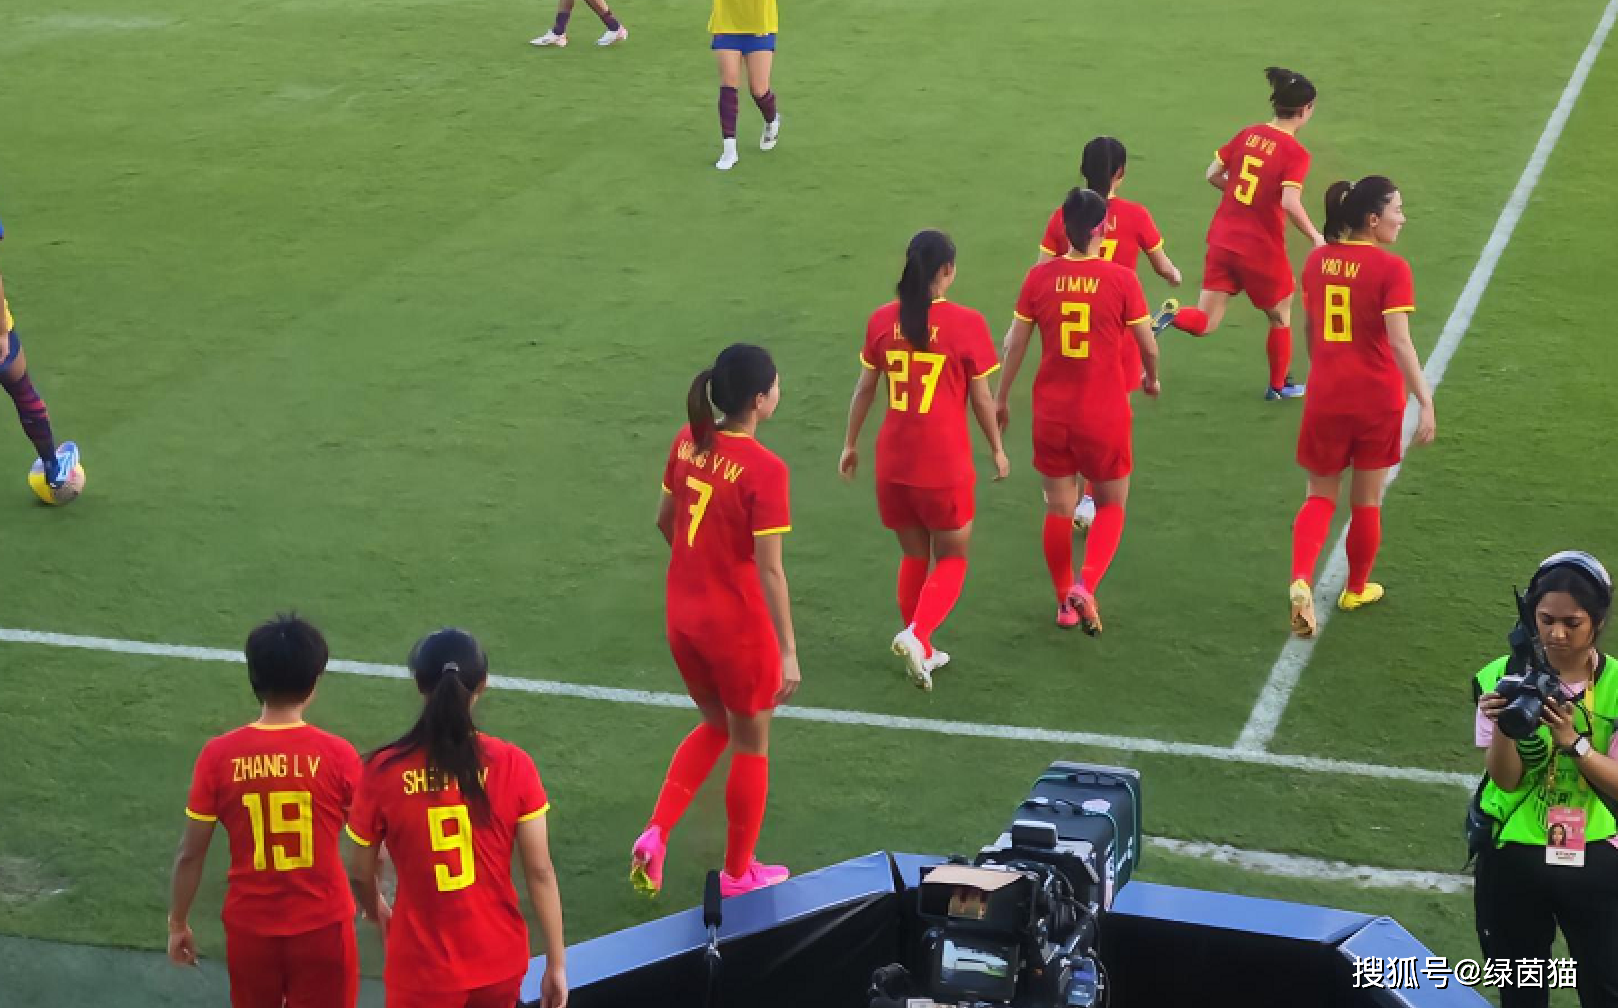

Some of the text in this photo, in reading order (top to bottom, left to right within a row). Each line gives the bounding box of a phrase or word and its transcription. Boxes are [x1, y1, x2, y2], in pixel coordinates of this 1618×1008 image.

[1233, 154, 1264, 205] 5
[1344, 260, 1361, 279] W
[1061, 302, 1091, 358] 2
[1324, 284, 1352, 342] 8
[885, 350, 947, 414] 27
[686, 474, 714, 548] 7
[231, 753, 287, 782] ZHANG
[242, 790, 314, 871] 19
[427, 804, 477, 891] 9
